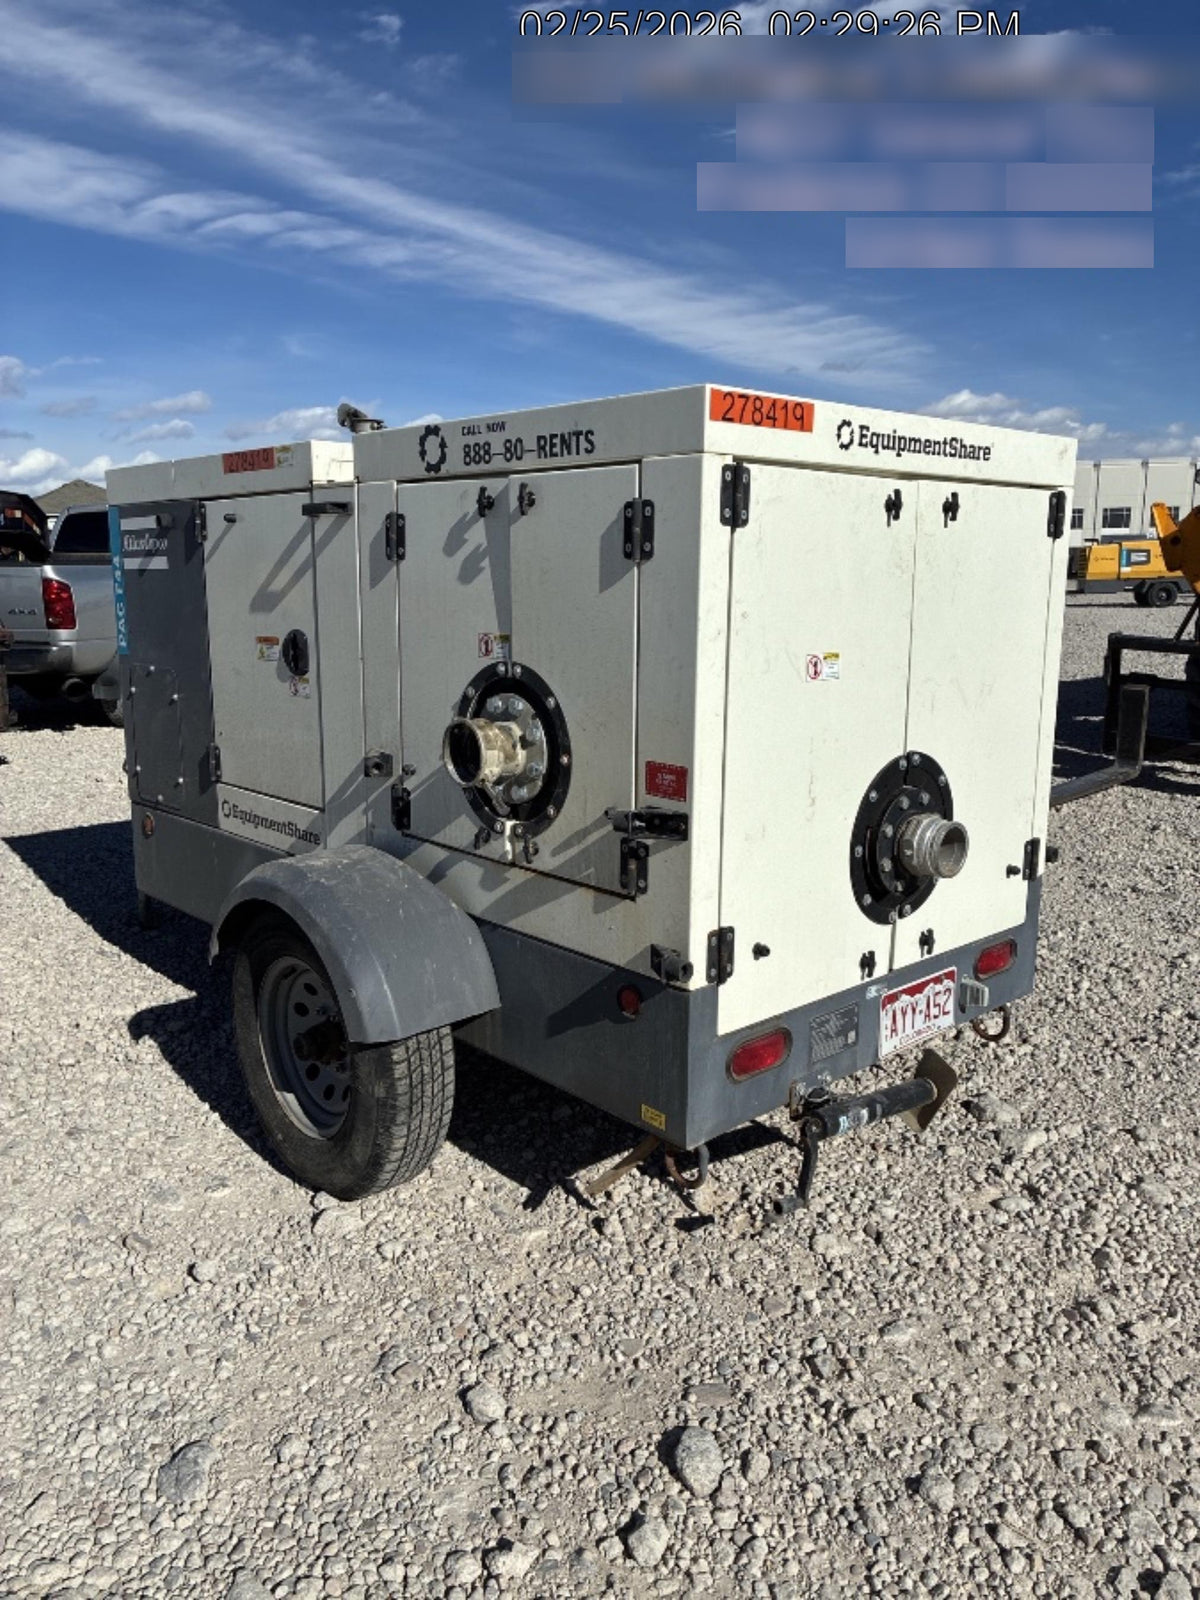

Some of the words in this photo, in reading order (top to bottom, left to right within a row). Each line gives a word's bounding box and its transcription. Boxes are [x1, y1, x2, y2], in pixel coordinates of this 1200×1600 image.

[461, 425, 482, 436] CALL
[486, 421, 507, 433] NOW
[721, 391, 805, 431] 278419
[463, 430, 596, 466] 888-80-RENTS
[858, 424, 992, 462] EquipmentShare
[232, 803, 321, 845] EquipmentShare
